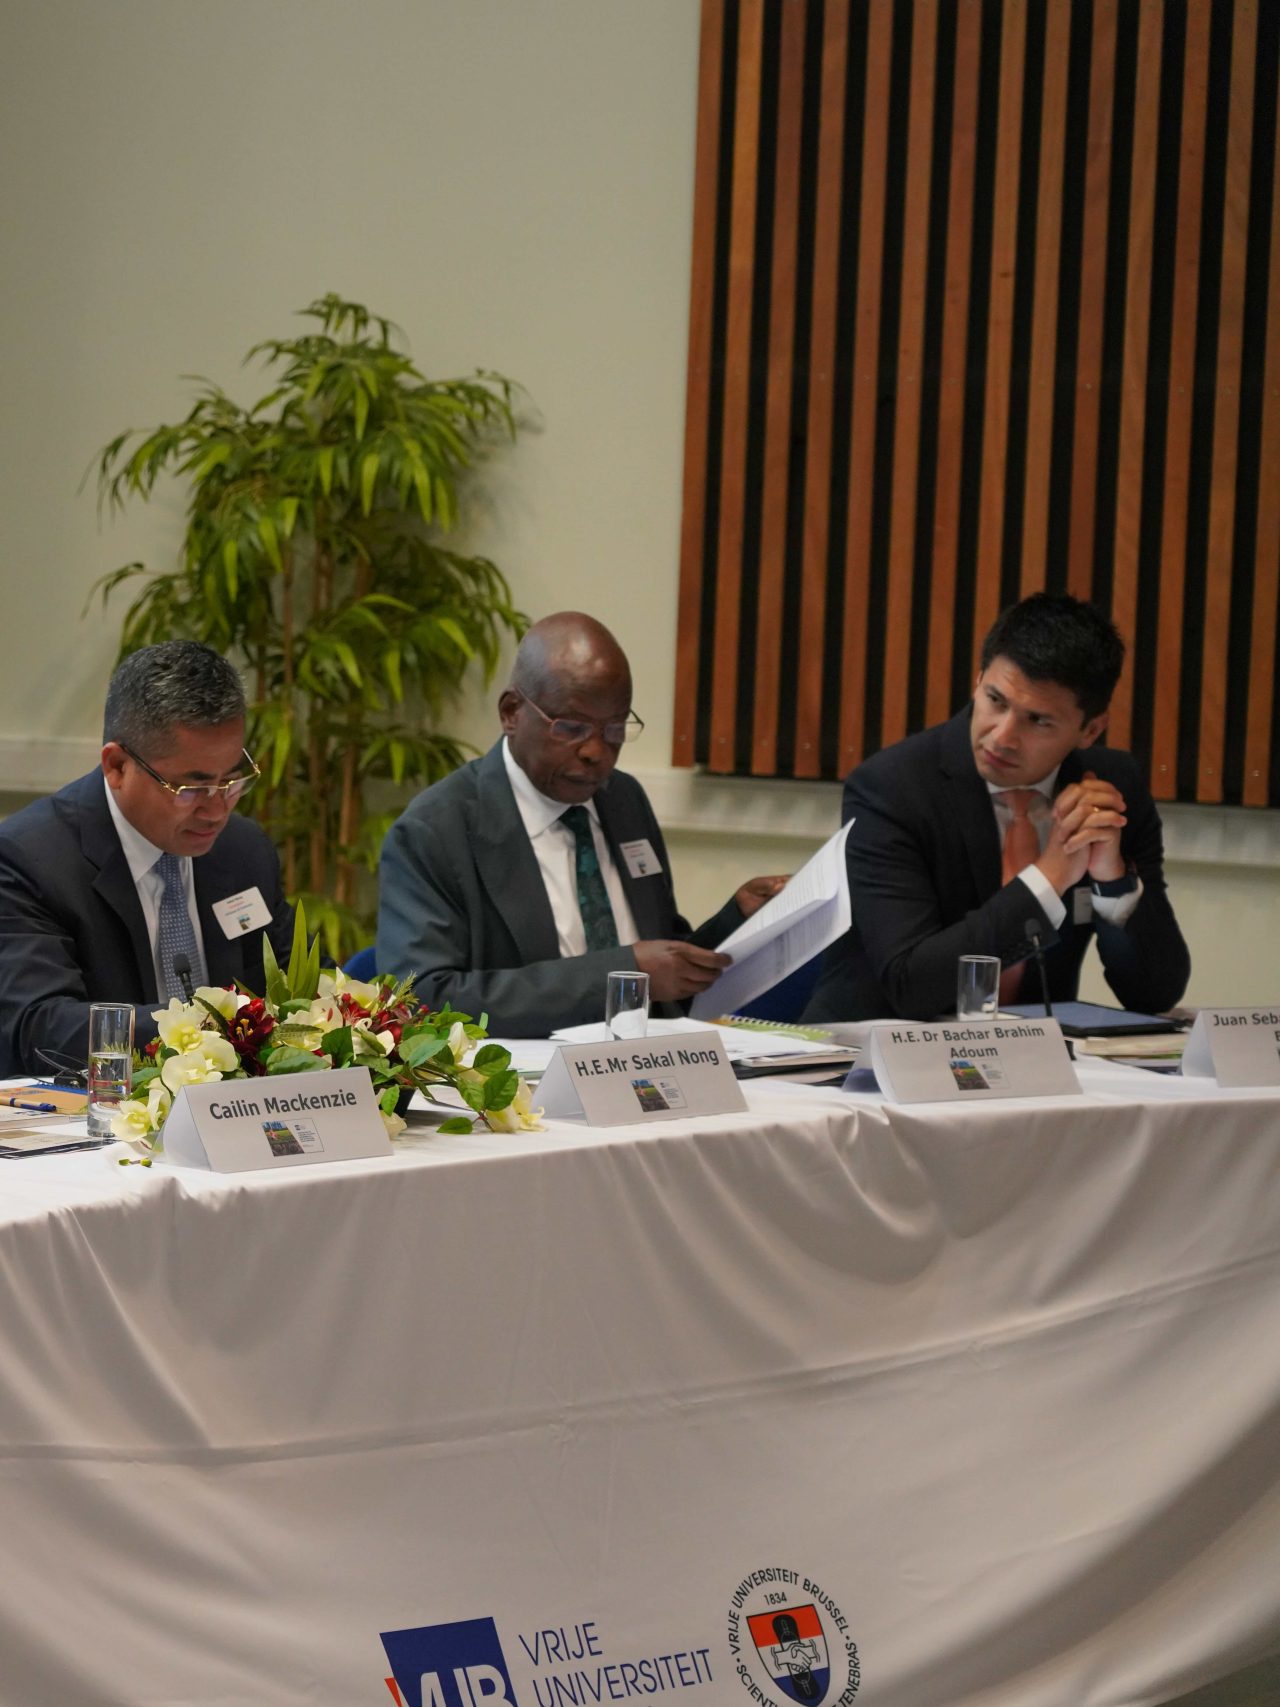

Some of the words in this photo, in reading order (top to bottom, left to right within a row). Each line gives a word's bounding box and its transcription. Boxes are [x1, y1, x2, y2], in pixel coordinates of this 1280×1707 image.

[891, 1031, 920, 1044] H.E.
[922, 1030, 938, 1042] Dr
[942, 1028, 990, 1042] Bachar
[994, 1025, 1045, 1038] Brahim
[1213, 1014, 1248, 1026] Juan
[1252, 1012, 1280, 1025] Seb
[632, 1051, 676, 1070] Sakal
[678, 1050, 720, 1067] Nong
[950, 1047, 999, 1059] Adoum
[209, 1100, 261, 1120] Cailin
[263, 1089, 358, 1114] Mackenzie
[731, 1568, 800, 1609] UNIVERSITEIT
[764, 1592, 787, 1606] 1834
[802, 1578, 850, 1634] BRUSSEL
[518, 1622, 603, 1666] VRIJE
[727, 1609, 740, 1656] VRIJE
[532, 1649, 714, 1707] UNIVERSITEIT
